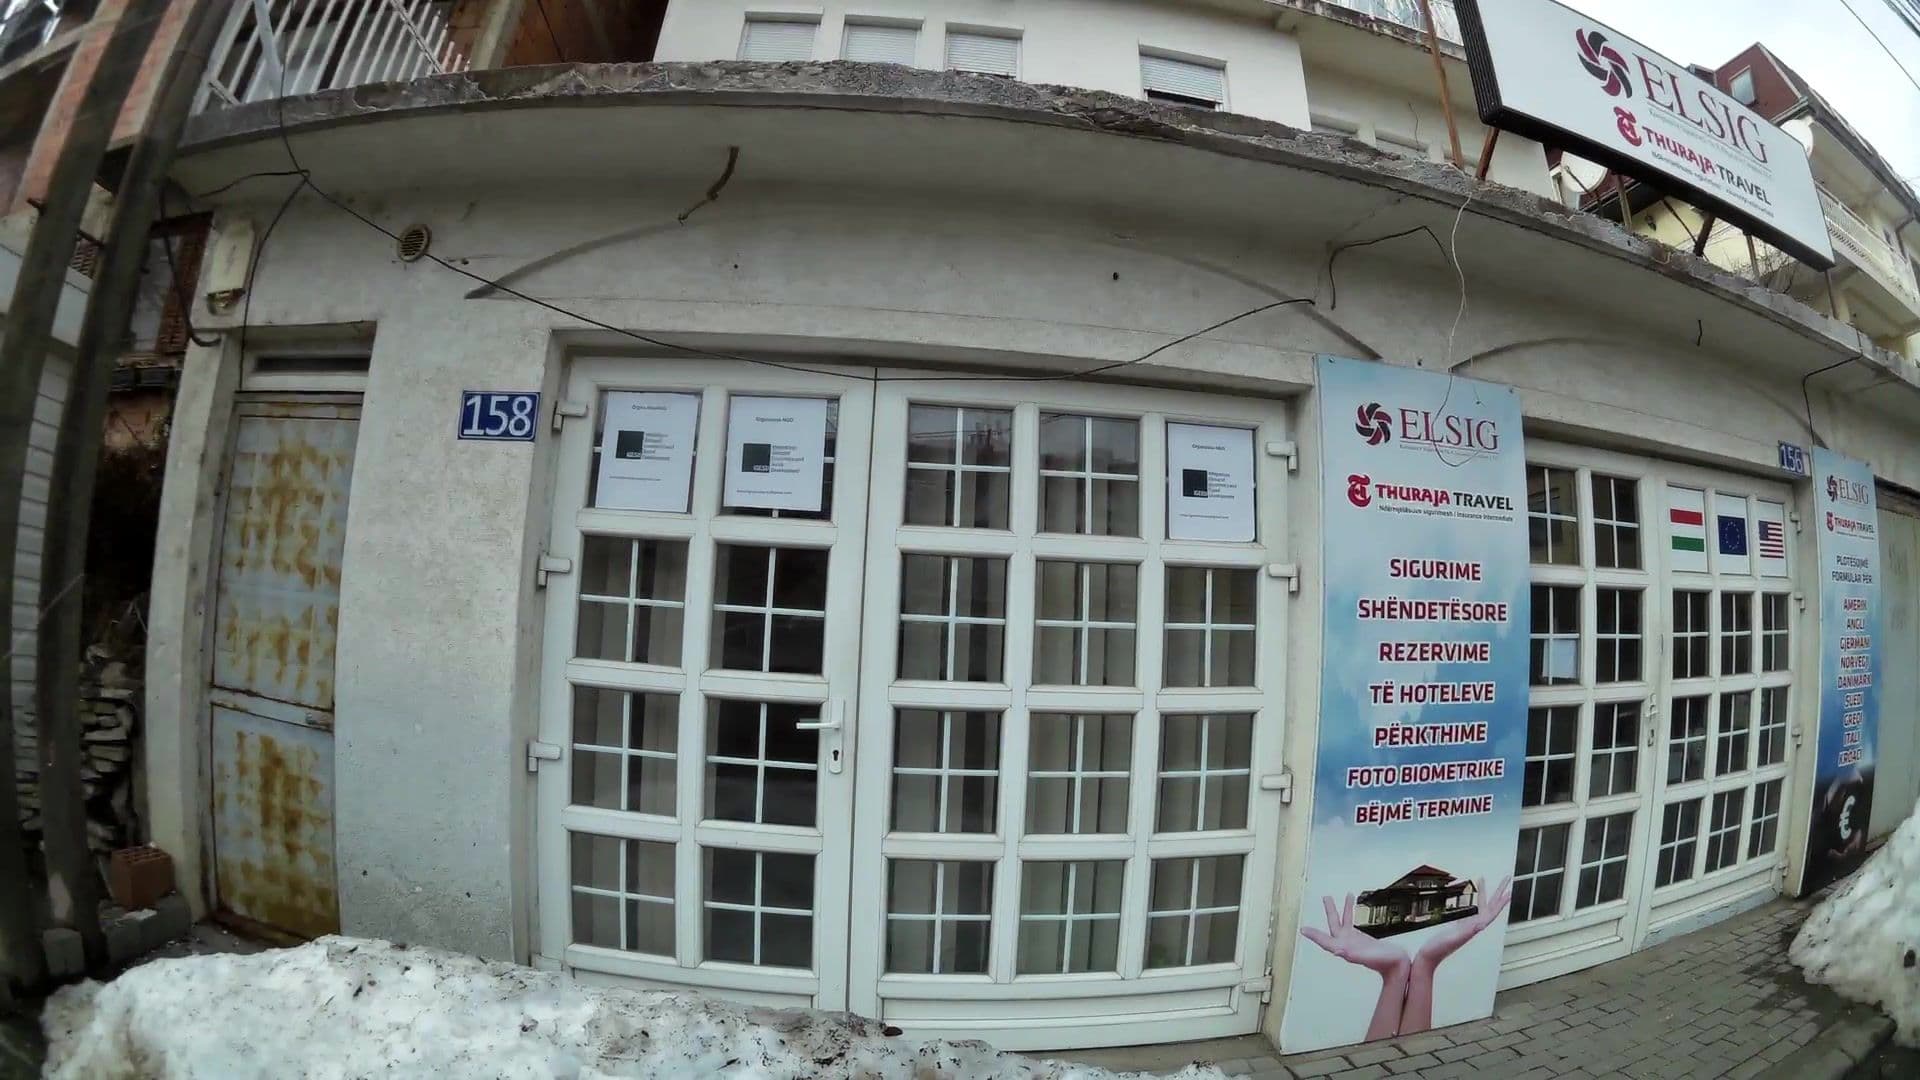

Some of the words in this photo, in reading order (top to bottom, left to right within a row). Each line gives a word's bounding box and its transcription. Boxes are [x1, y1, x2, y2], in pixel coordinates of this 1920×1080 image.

[1632, 52, 1768, 164] ELSIG
[1642, 125, 1717, 175] THURAJA
[1716, 164, 1772, 206] TRAVEL
[463, 395, 532, 436] 158
[1398, 408, 1499, 451] ELSIG
[1781, 444, 1804, 473] 156
[1375, 484, 1450, 507] THURAJA
[1453, 492, 1513, 511] TRAVEL
[1839, 478, 1869, 504] ELSIG
[1390, 559, 1481, 581] SIGURIME
[1359, 596, 1507, 622] SHËNDETËSORE
[1380, 642, 1489, 662] REZERVIME
[1370, 681, 1394, 704] TË
[1400, 684, 1494, 703] HOTELEVE
[1375, 723, 1486, 746] PËRKTHIME
[1348, 767, 1395, 786] FOTO
[1401, 759, 1503, 783] BIOMETRIKE
[1356, 801, 1411, 825] BËJMË
[1418, 796, 1492, 818] TERMINE
